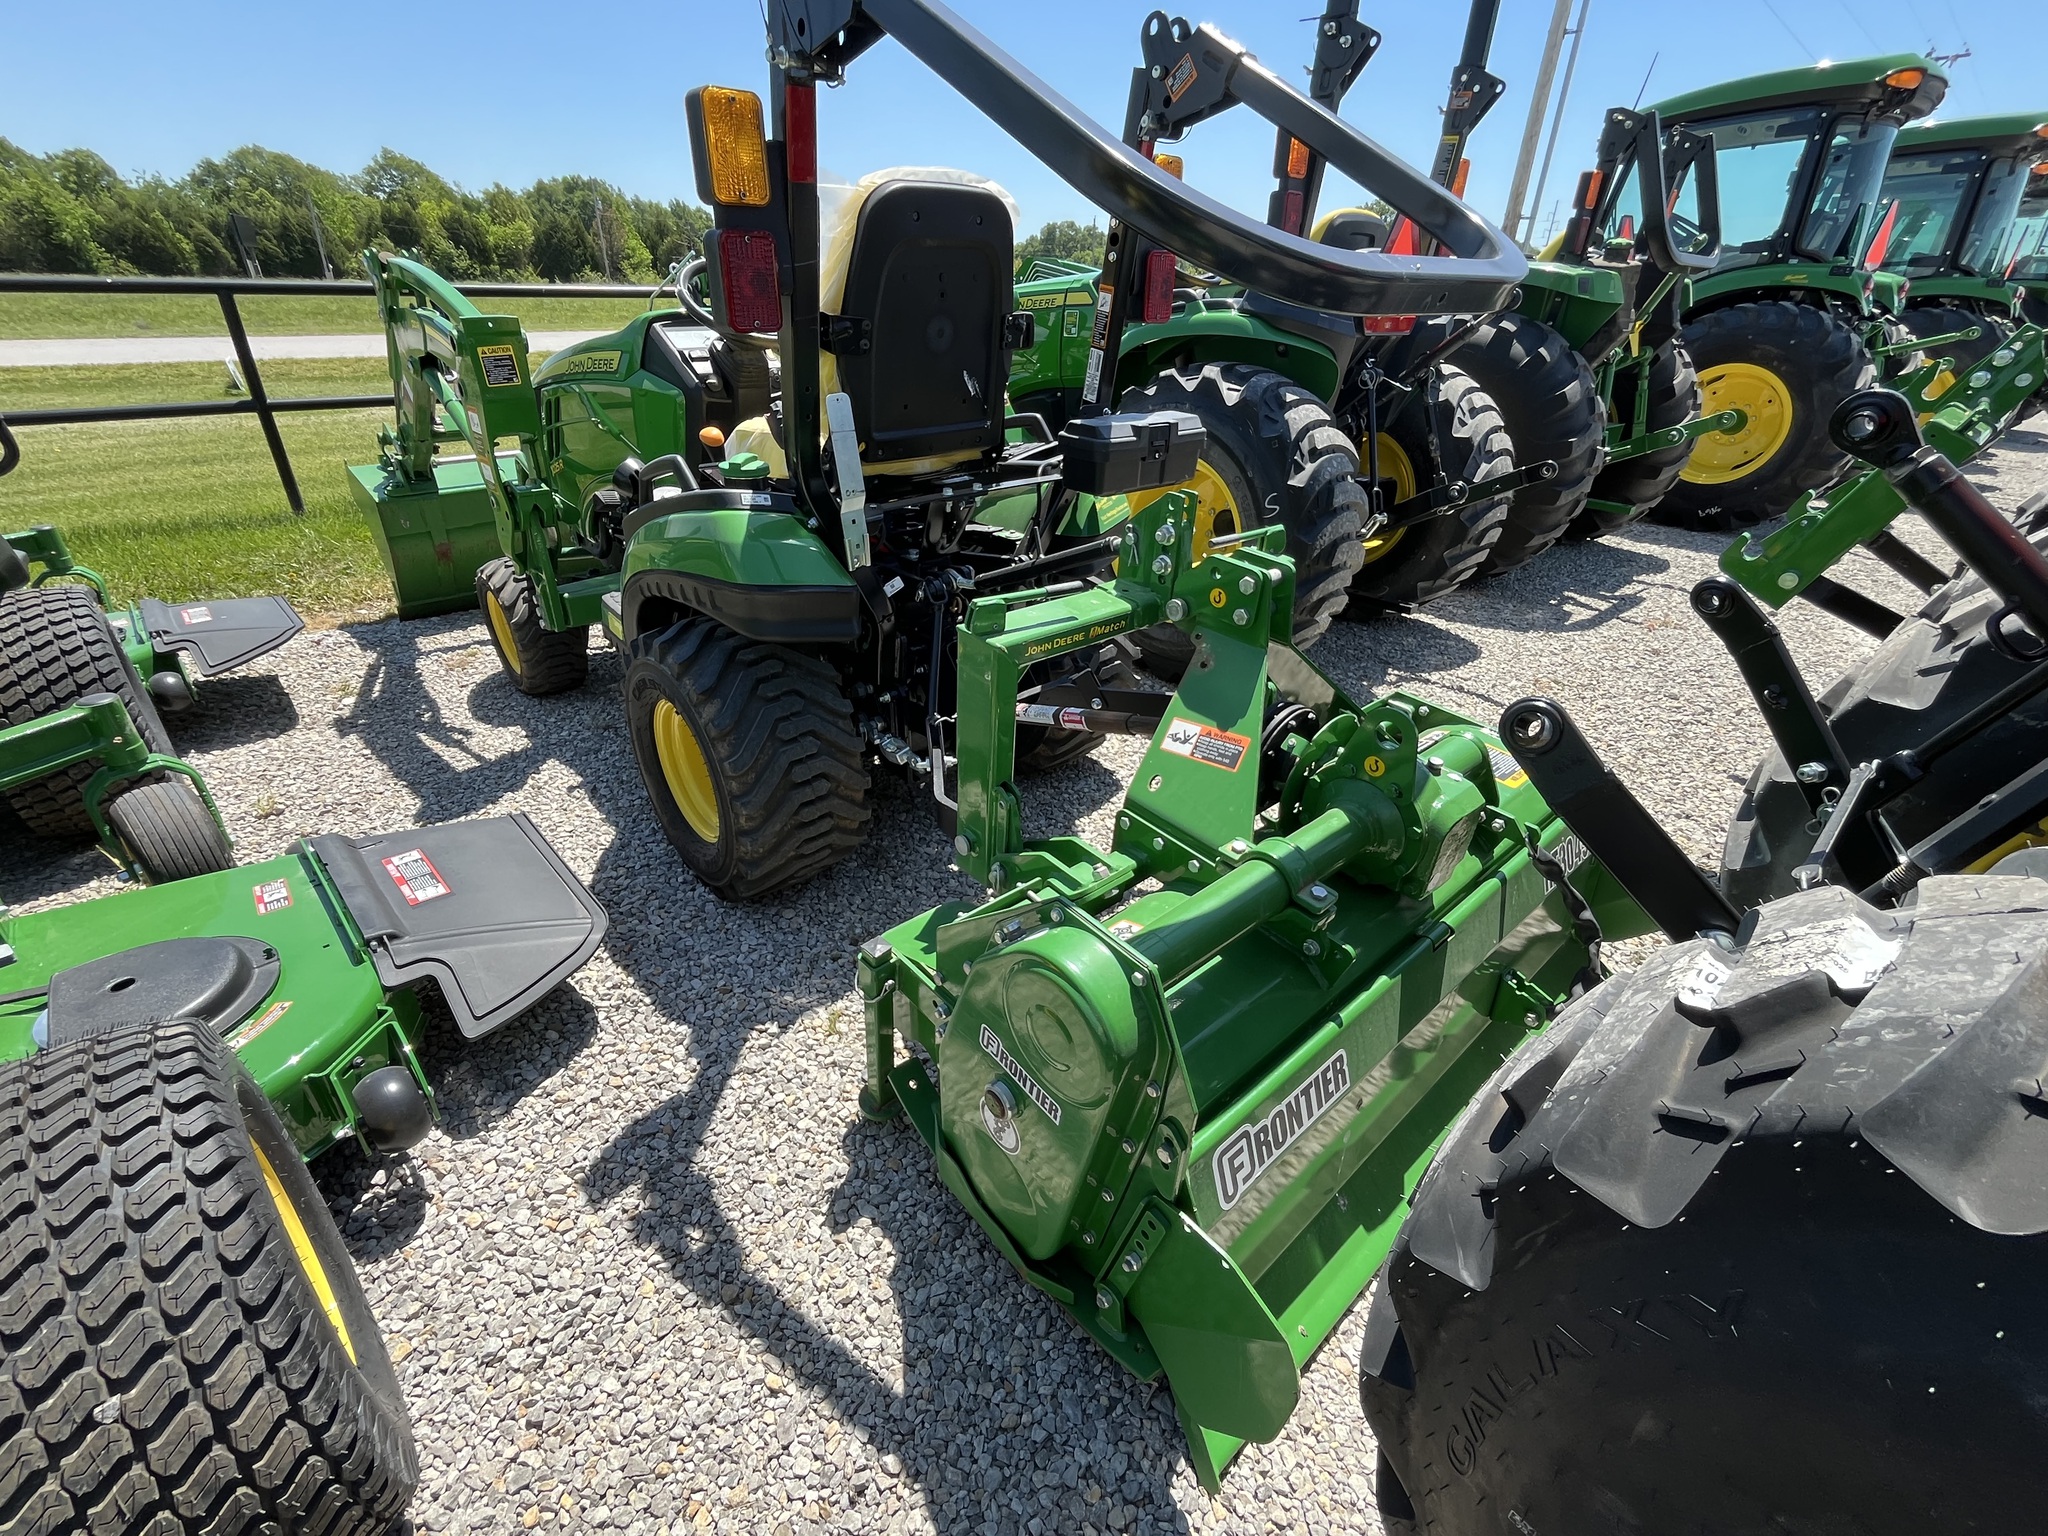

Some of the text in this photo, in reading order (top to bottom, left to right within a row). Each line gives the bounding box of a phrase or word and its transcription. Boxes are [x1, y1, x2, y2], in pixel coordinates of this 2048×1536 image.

[1025, 298, 1057, 309] DEERE
[487, 346, 512, 354] CAUTION
[565, 356, 615, 373] JOHN DEERE
[1025, 642, 1052, 657] JOHN
[1053, 632, 1085, 648] DEERE
[1212, 733, 1243, 745] WARNING
[981, 1025, 1060, 1122] FRONTIER
[1216, 1053, 1349, 1205] FRONTIER
